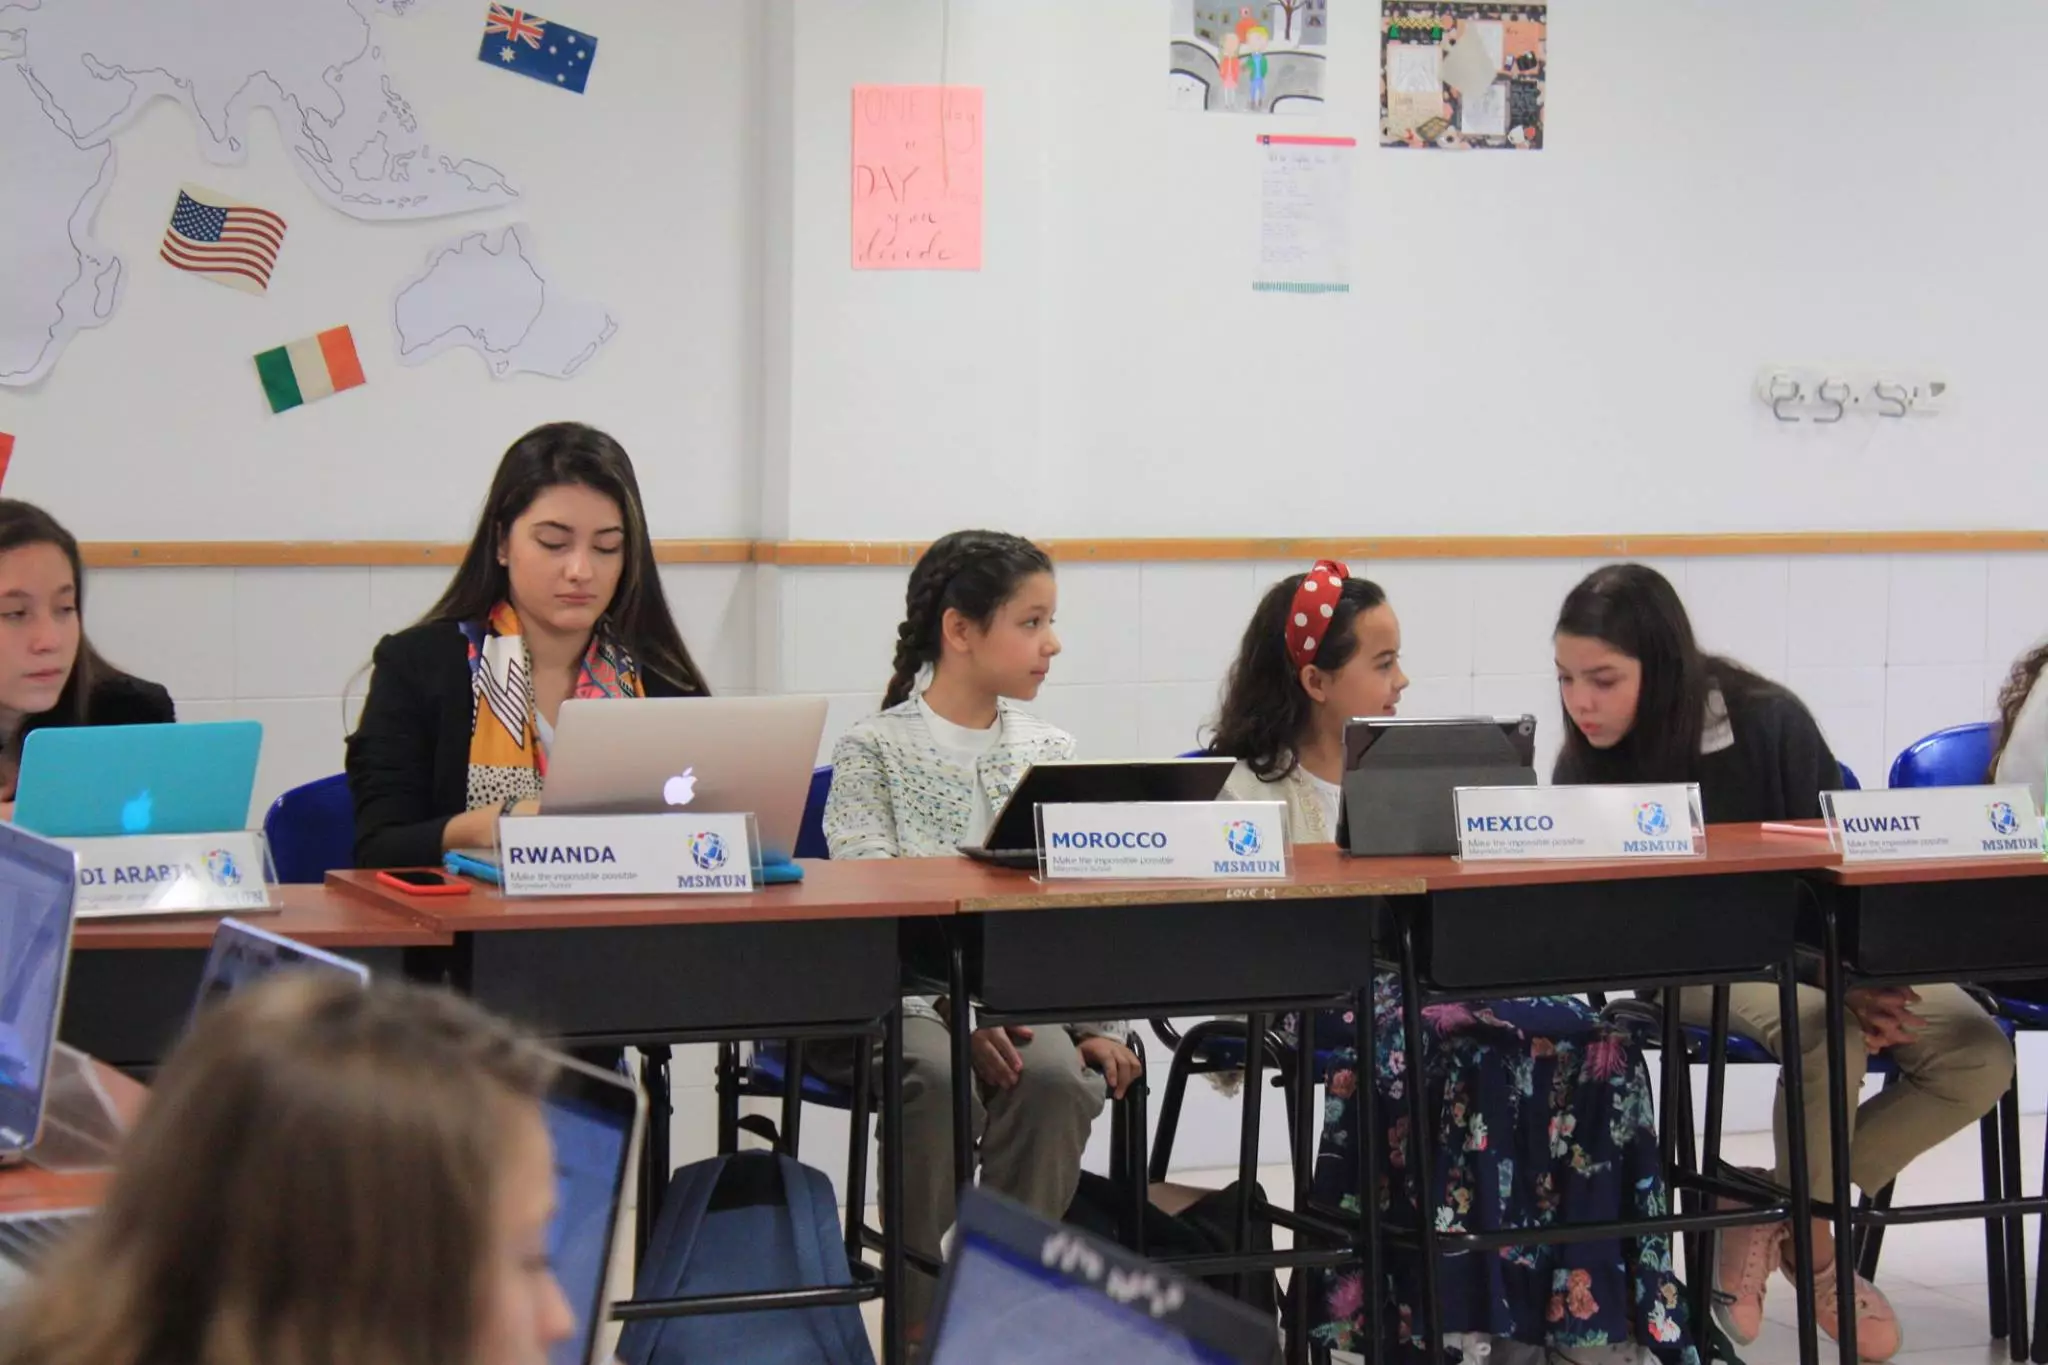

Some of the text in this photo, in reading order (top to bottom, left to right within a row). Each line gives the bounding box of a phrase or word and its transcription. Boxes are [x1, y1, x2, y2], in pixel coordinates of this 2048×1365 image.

[856, 165, 921, 205] DAY
[1466, 815, 1554, 833] MEXICO
[1842, 815, 1922, 834] KUWAIT
[1052, 831, 1168, 849] MOROCCO
[1623, 840, 1689, 853] MSMUN
[1982, 837, 2039, 852] MSMUN
[509, 845, 617, 865] RWANDA
[1213, 860, 1281, 873] MSMUN
[79, 867, 107, 886] DI
[537, 871, 552, 881] the
[677, 874, 747, 889] MSMUN
